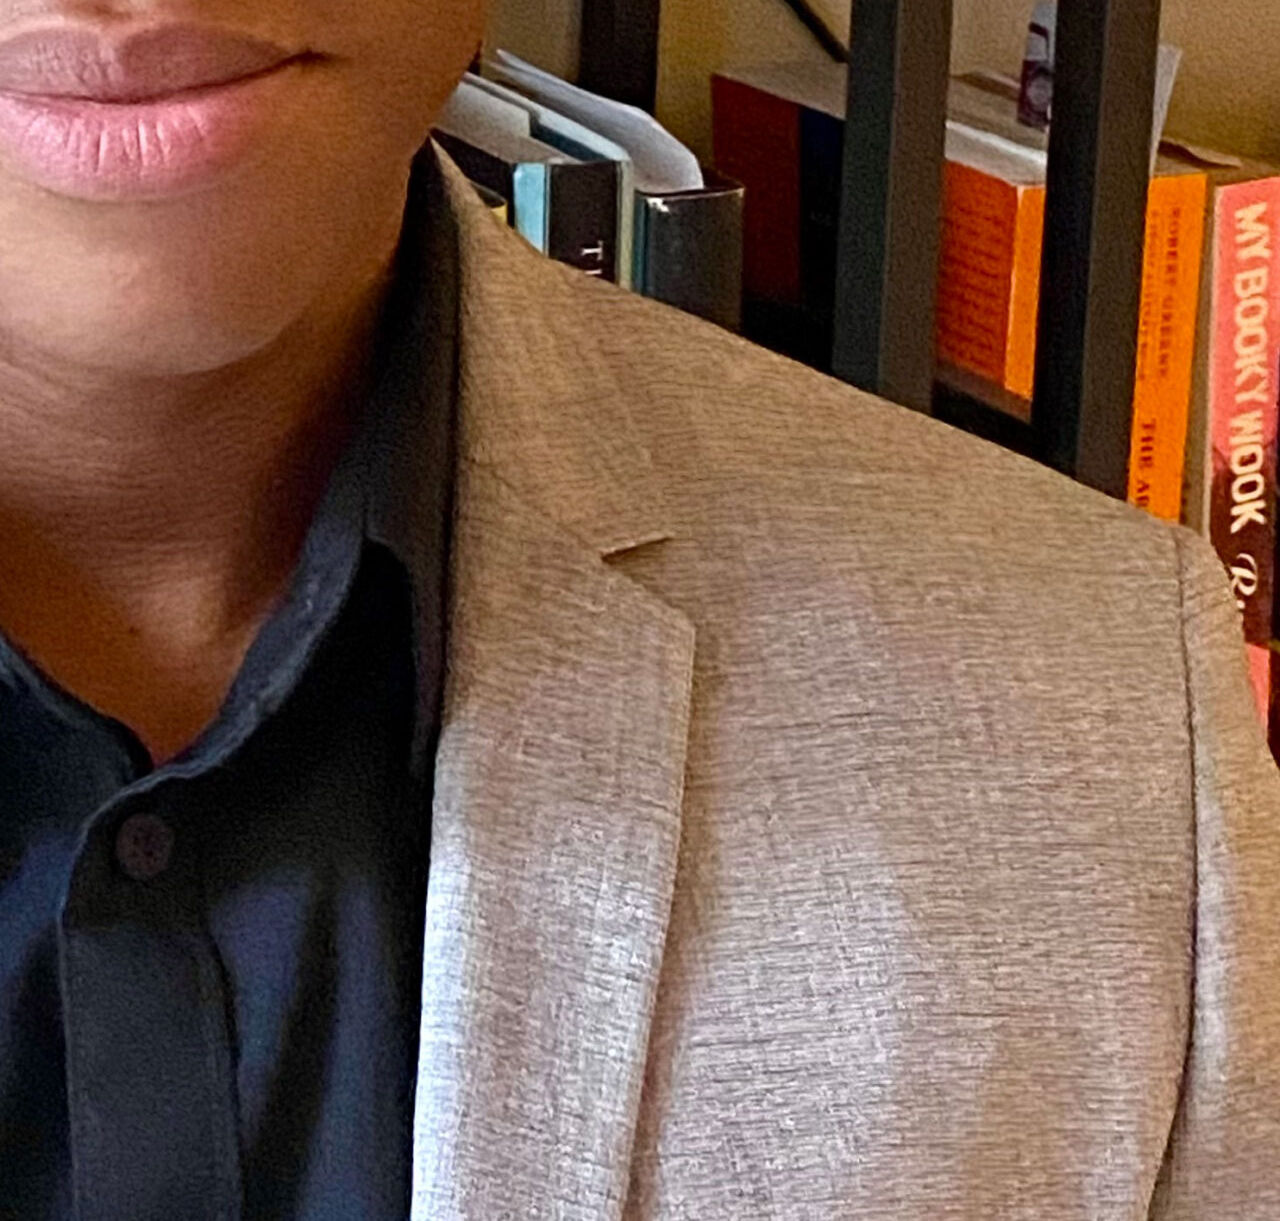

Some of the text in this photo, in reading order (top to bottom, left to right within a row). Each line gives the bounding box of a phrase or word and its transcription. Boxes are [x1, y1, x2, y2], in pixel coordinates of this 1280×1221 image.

[1236, 202, 1272, 260] MY
[1234, 266, 1270, 406] BOOKY
[1230, 407, 1267, 535] WOOK
